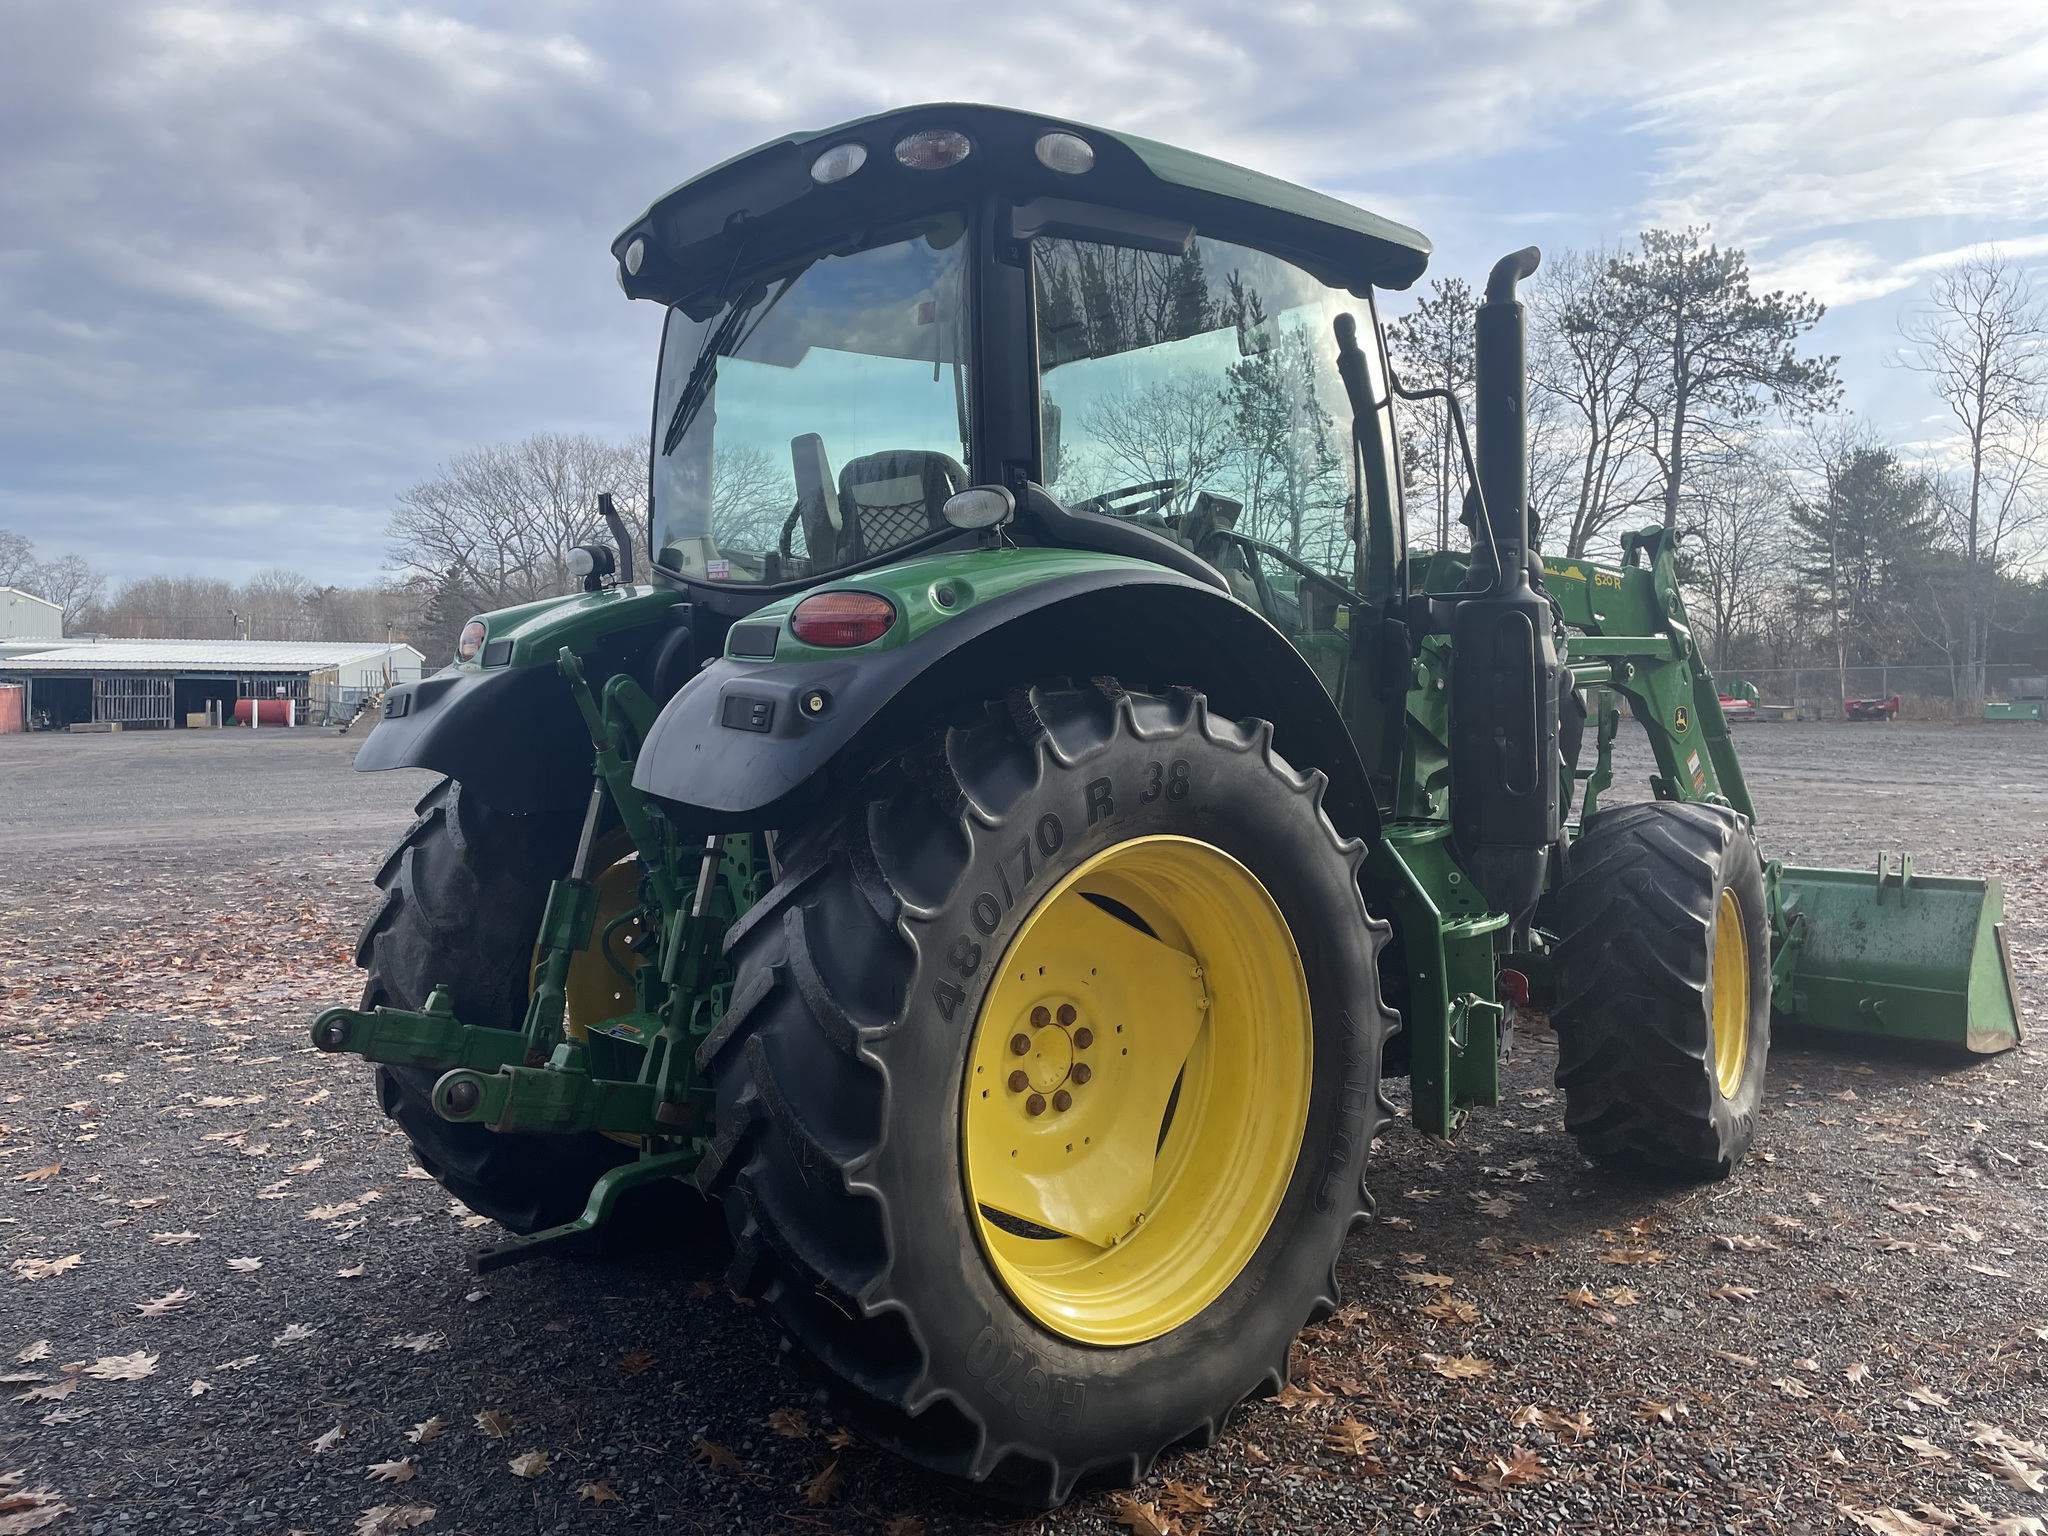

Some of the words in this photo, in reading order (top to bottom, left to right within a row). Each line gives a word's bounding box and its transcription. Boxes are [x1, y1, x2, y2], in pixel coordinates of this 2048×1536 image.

[932, 811, 1065, 1023] 480/70
[1083, 775, 1115, 828] R
[1139, 758, 1192, 806] 38
